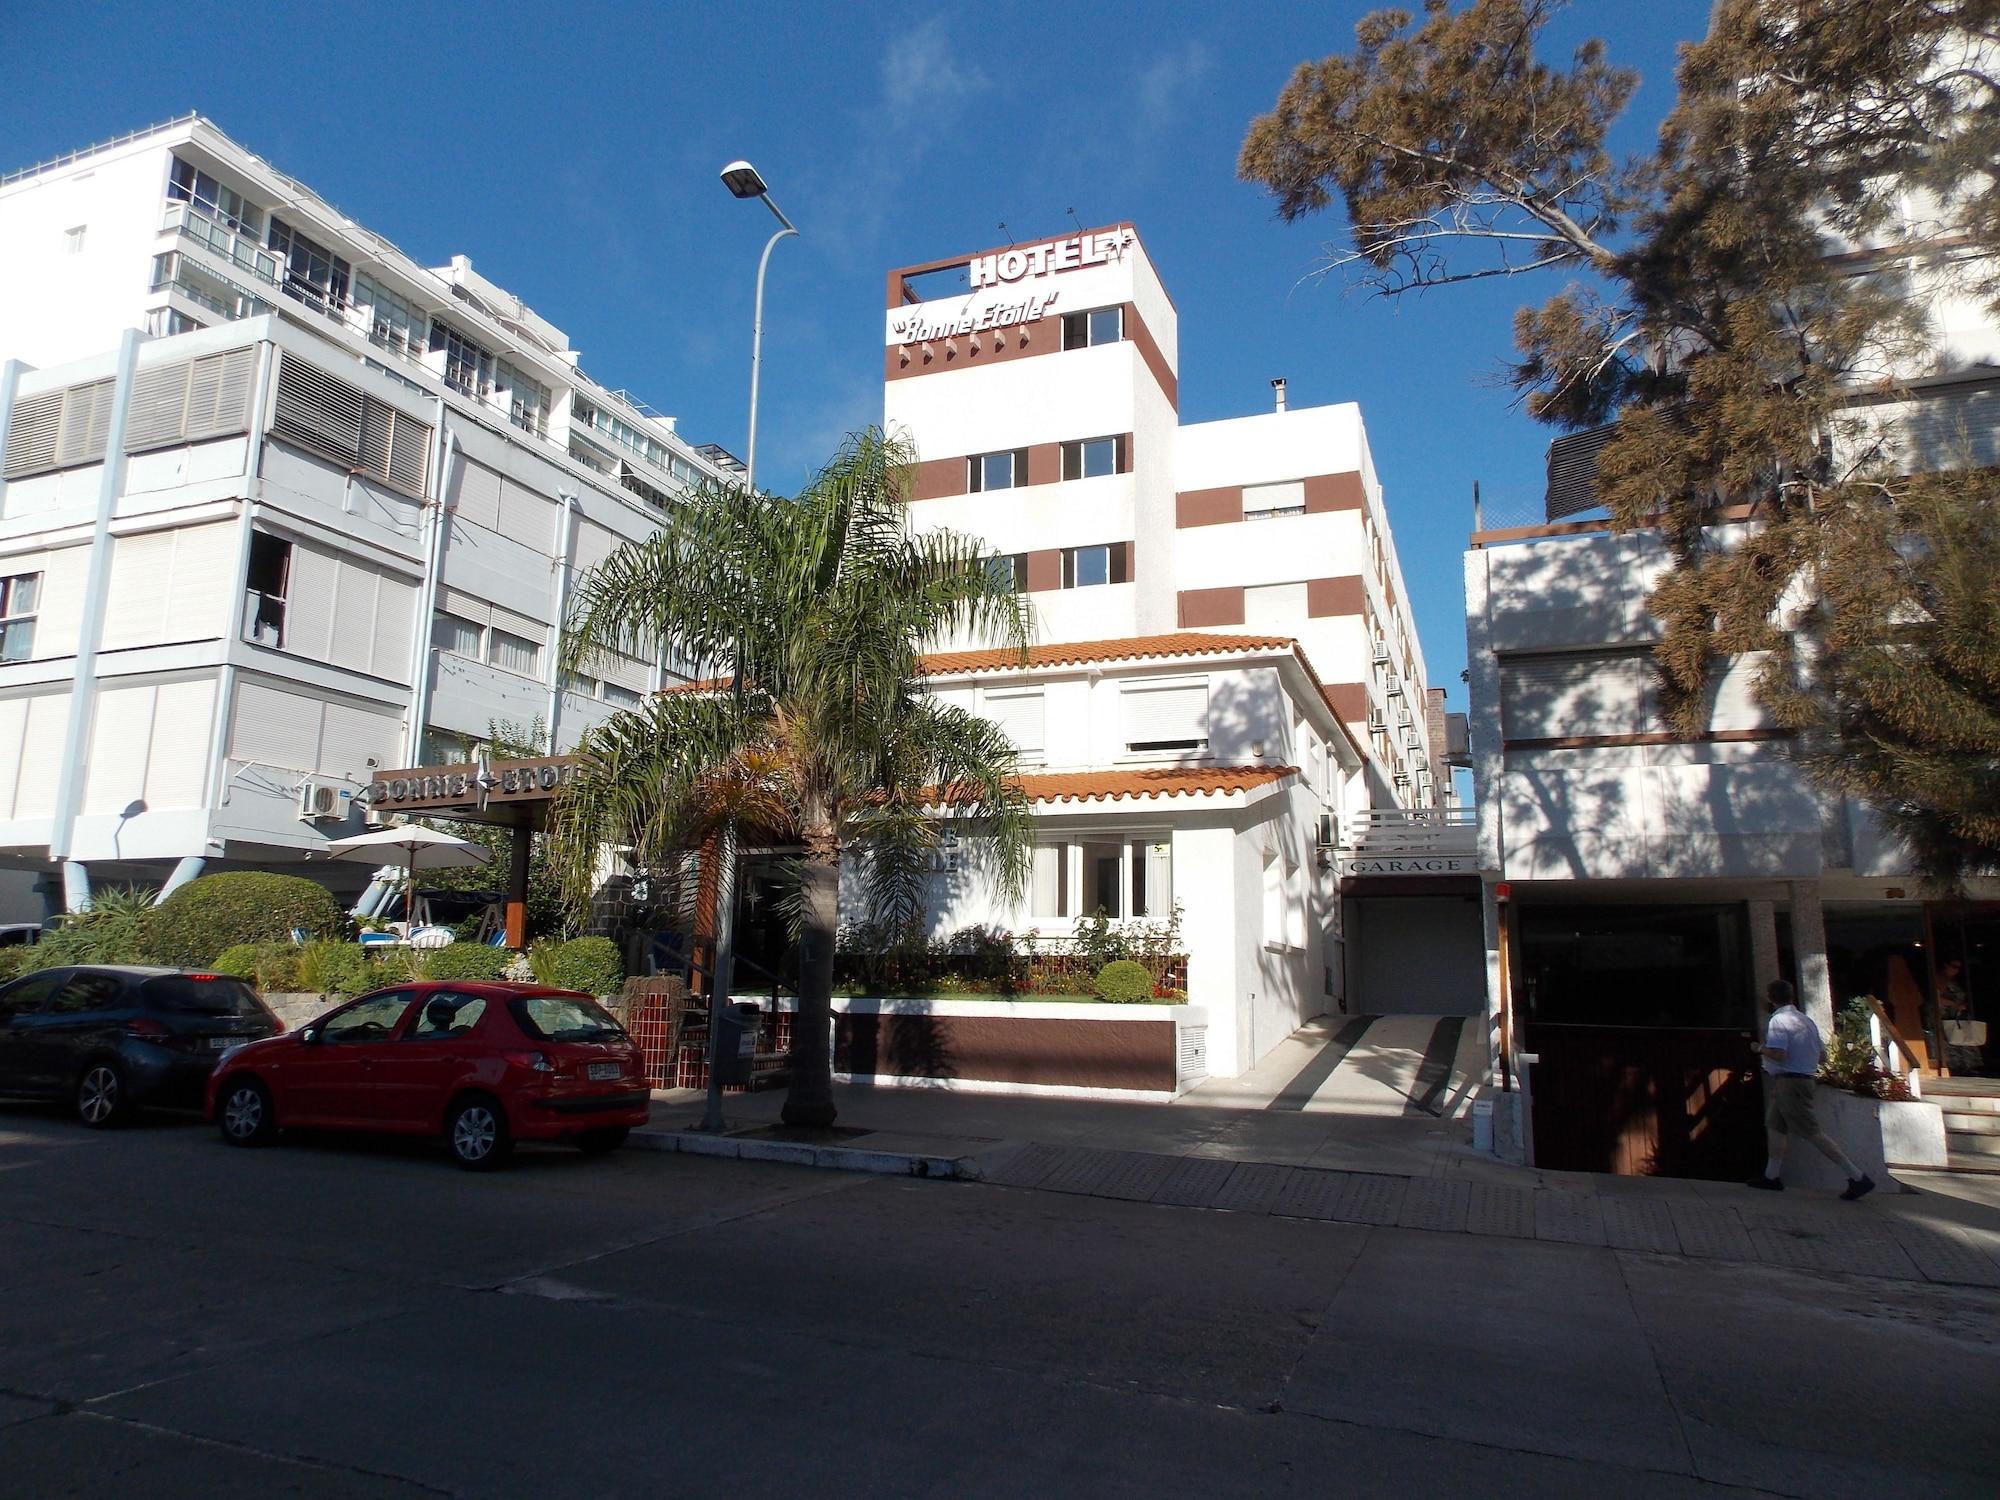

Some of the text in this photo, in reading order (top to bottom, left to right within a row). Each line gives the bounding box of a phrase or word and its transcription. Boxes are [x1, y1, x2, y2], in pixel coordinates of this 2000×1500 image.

[970, 232, 1109, 289] HOTEL
[367, 773, 467, 803] BONNE
[1350, 859, 1461, 873] GARAGE
